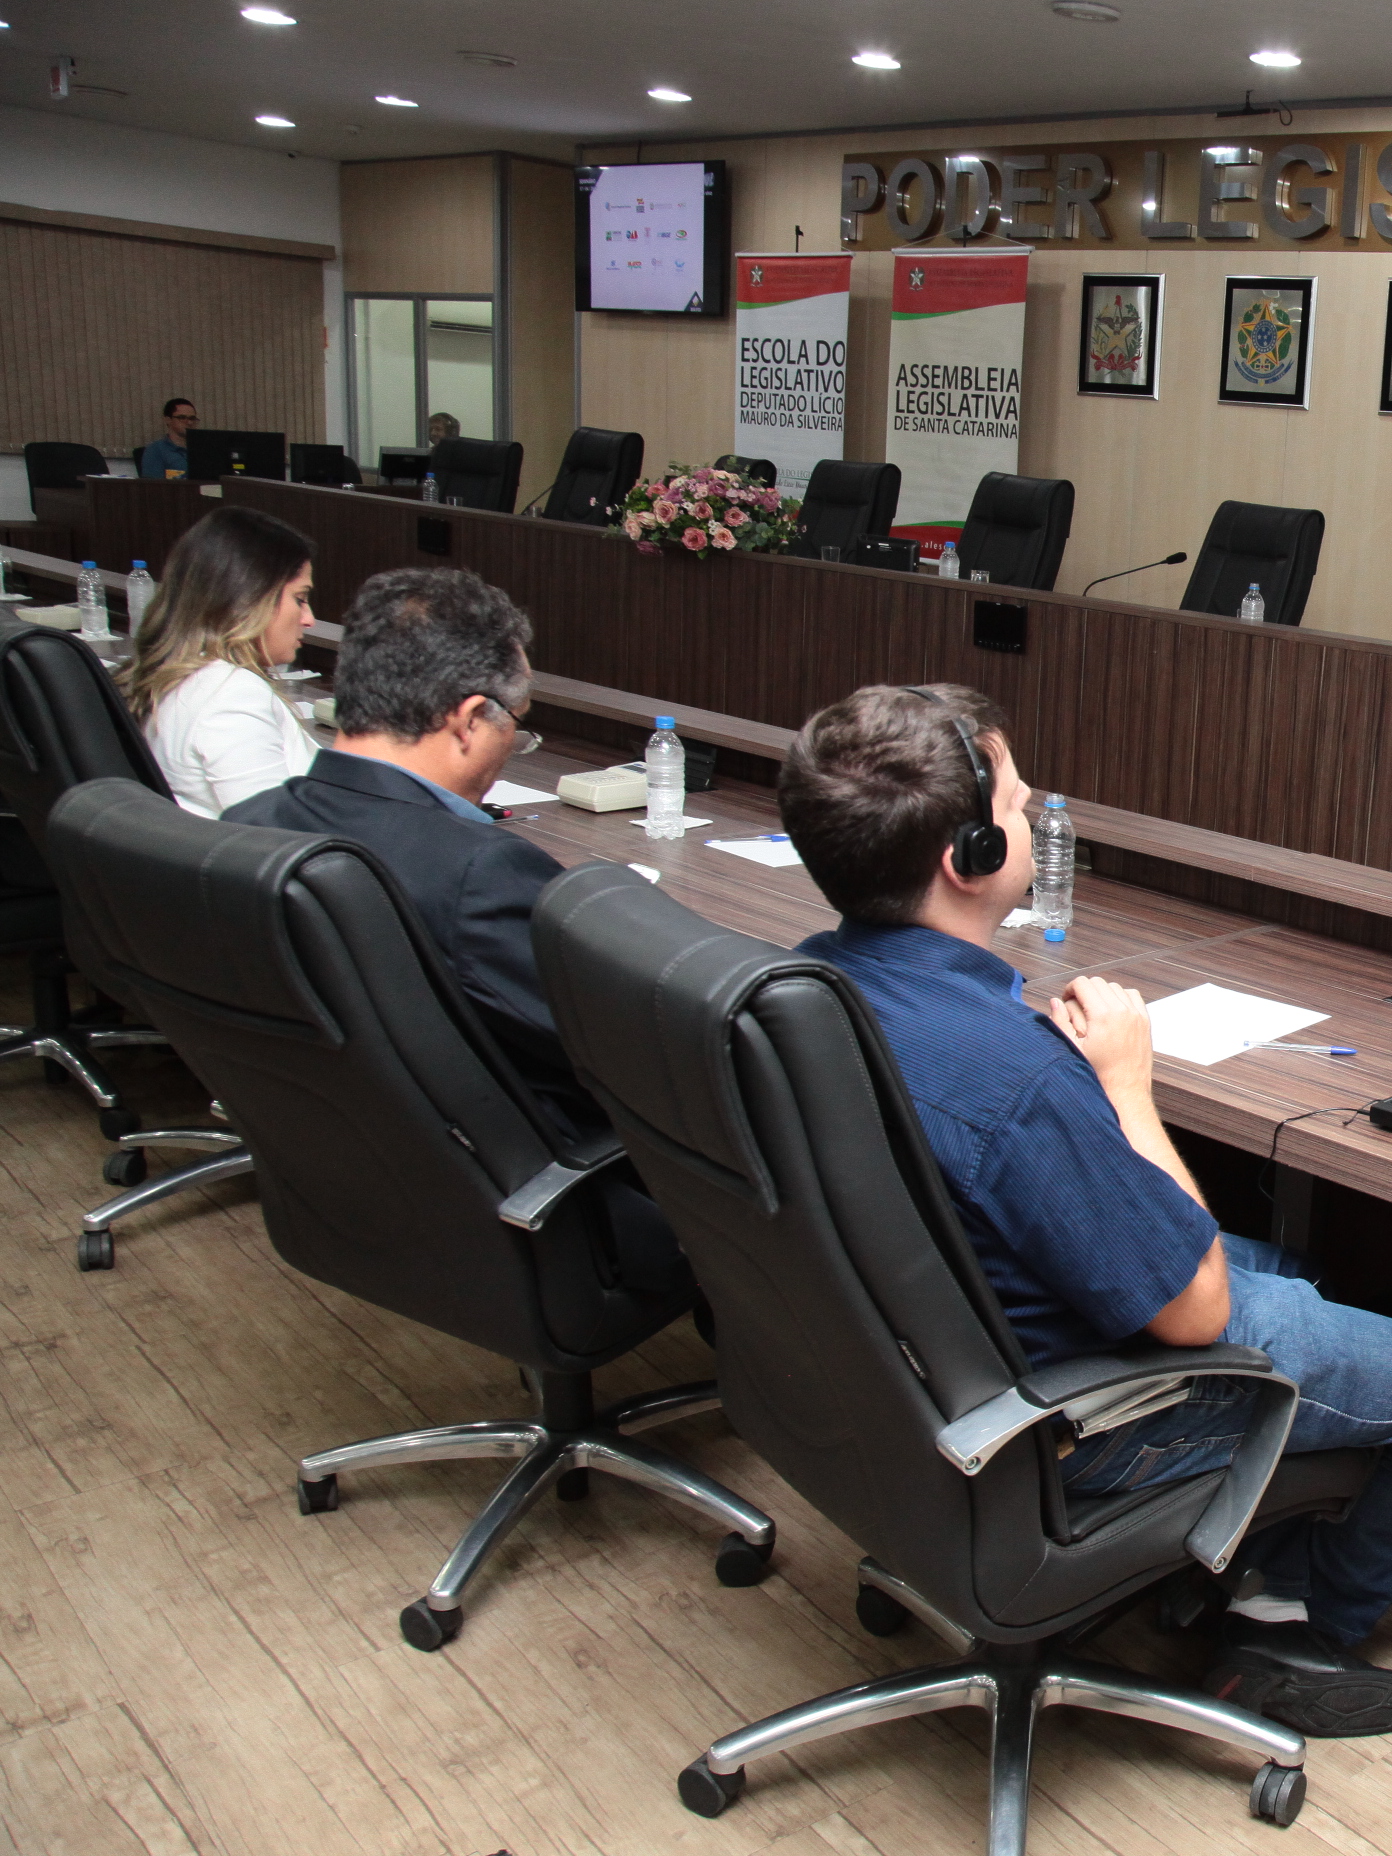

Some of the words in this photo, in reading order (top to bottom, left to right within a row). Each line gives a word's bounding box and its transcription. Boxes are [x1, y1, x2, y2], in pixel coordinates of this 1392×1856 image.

[840, 153, 1113, 241] PODER
[740, 337, 809, 366] ESCOLA
[816, 340, 846, 368] DO
[740, 366, 845, 394] LEGISLATIVO
[895, 363, 1020, 393] ASSEMBLEIA
[740, 391, 808, 412] DEPUTADO
[811, 392, 844, 415] LÍCIO
[895, 390, 1019, 421] LEGISLATIVA
[740, 410, 777, 427] MAURO
[779, 413, 794, 428] DA
[797, 414, 844, 431] SILVEIRA
[894, 416, 910, 431] DE
[912, 417, 950, 434] SANTA
[953, 419, 1018, 439] CATARINA
